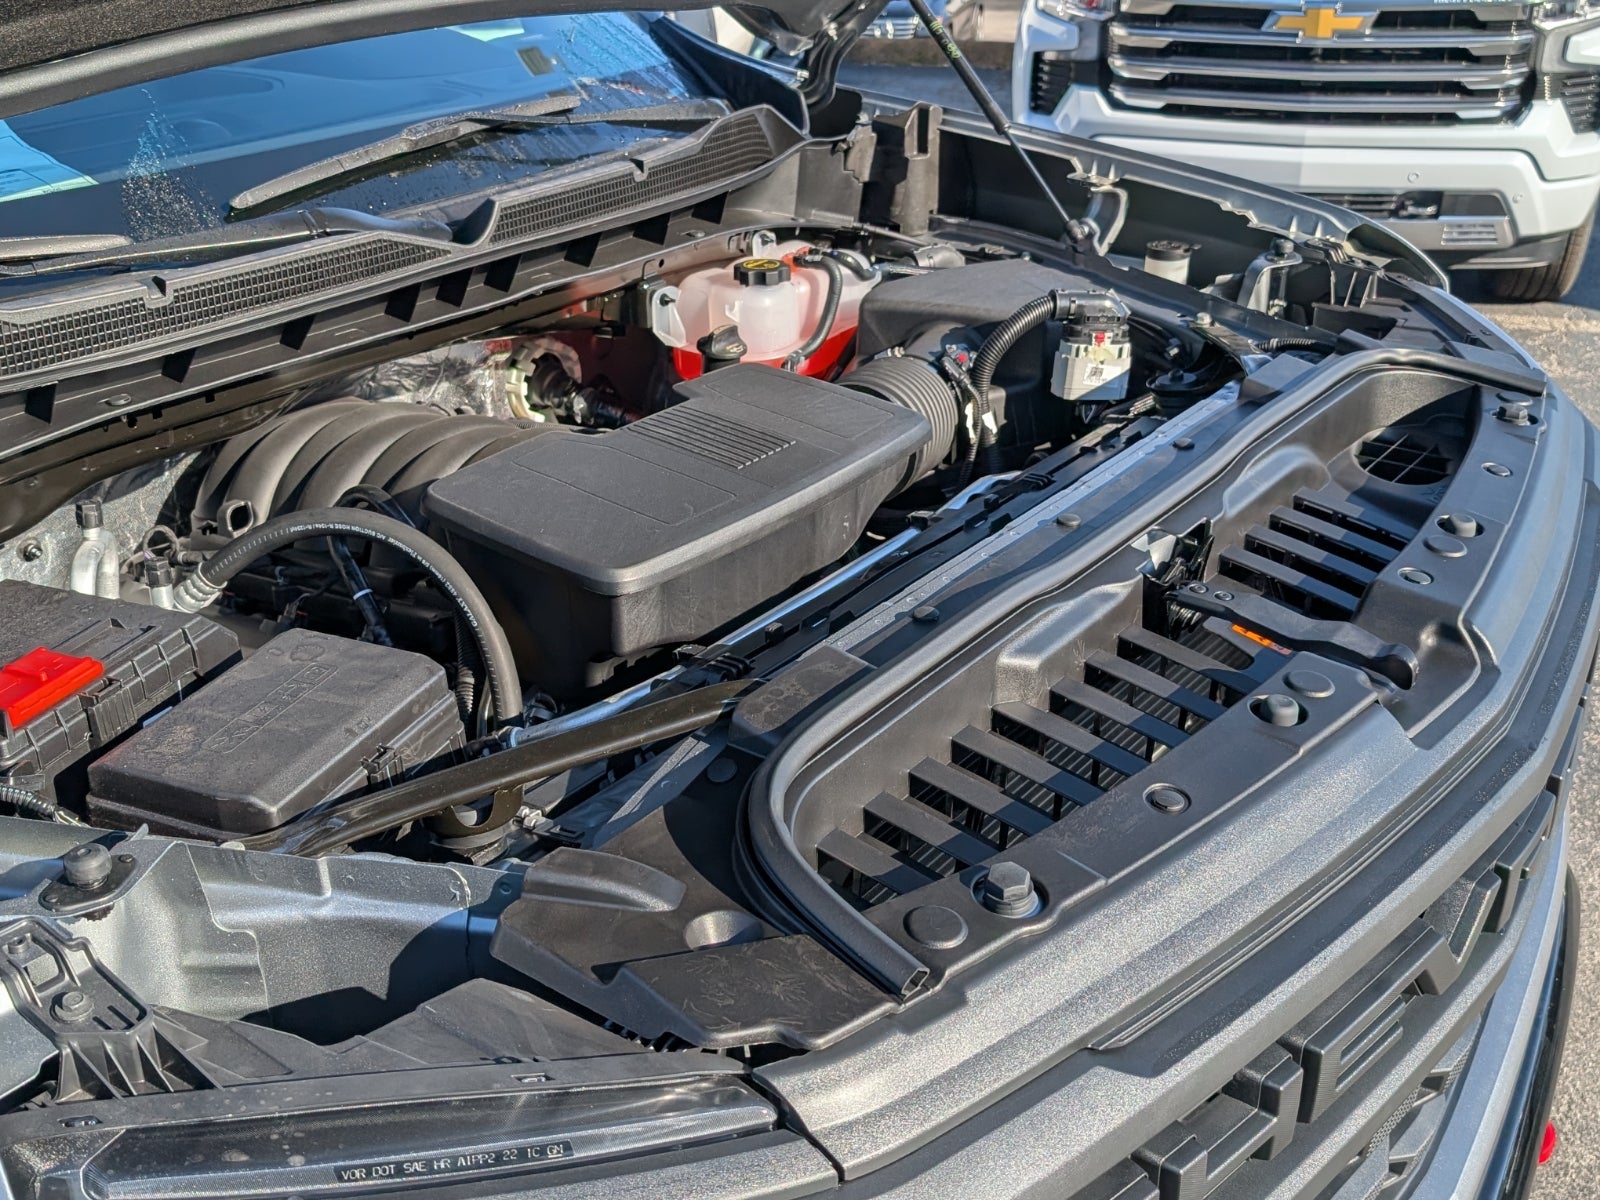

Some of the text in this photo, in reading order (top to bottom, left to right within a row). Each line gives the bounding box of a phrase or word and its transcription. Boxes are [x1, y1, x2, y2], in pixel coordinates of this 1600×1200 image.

[456, 598, 477, 627] GALAXY
[341, 1168, 367, 1180] VOR
[372, 1164, 396, 1177] DOT
[403, 1161, 427, 1174] SAE
[433, 1158, 450, 1170] HR
[502, 1149, 518, 1161] 22
[546, 1144, 564, 1158] GM
